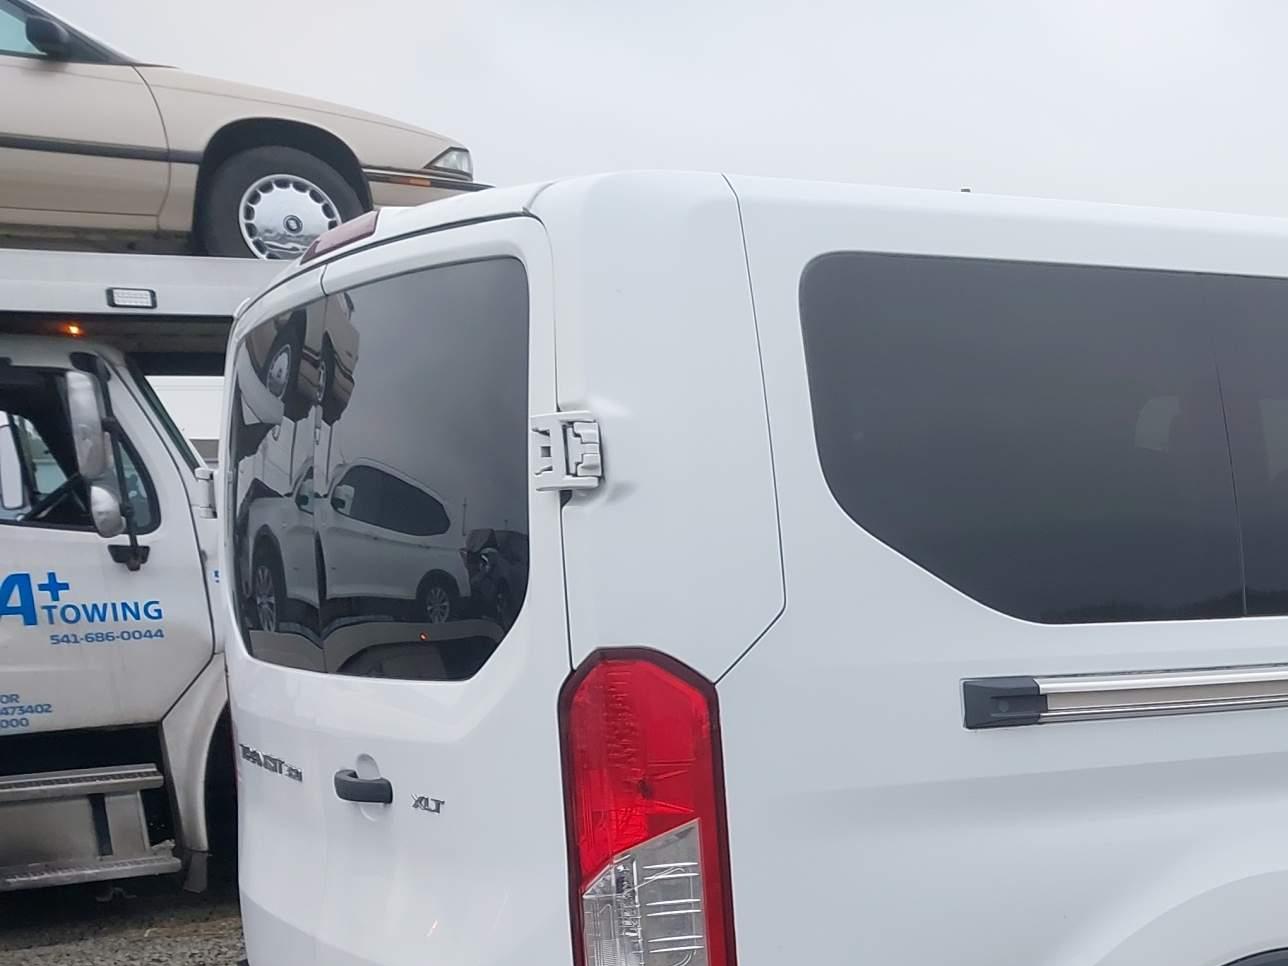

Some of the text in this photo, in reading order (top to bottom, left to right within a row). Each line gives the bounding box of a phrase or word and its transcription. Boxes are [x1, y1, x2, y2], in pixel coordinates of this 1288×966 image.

[41, 600, 163, 625] TOWING
[50, 628, 165, 645] 541-686-0044
[411, 793, 445, 814] XLT
